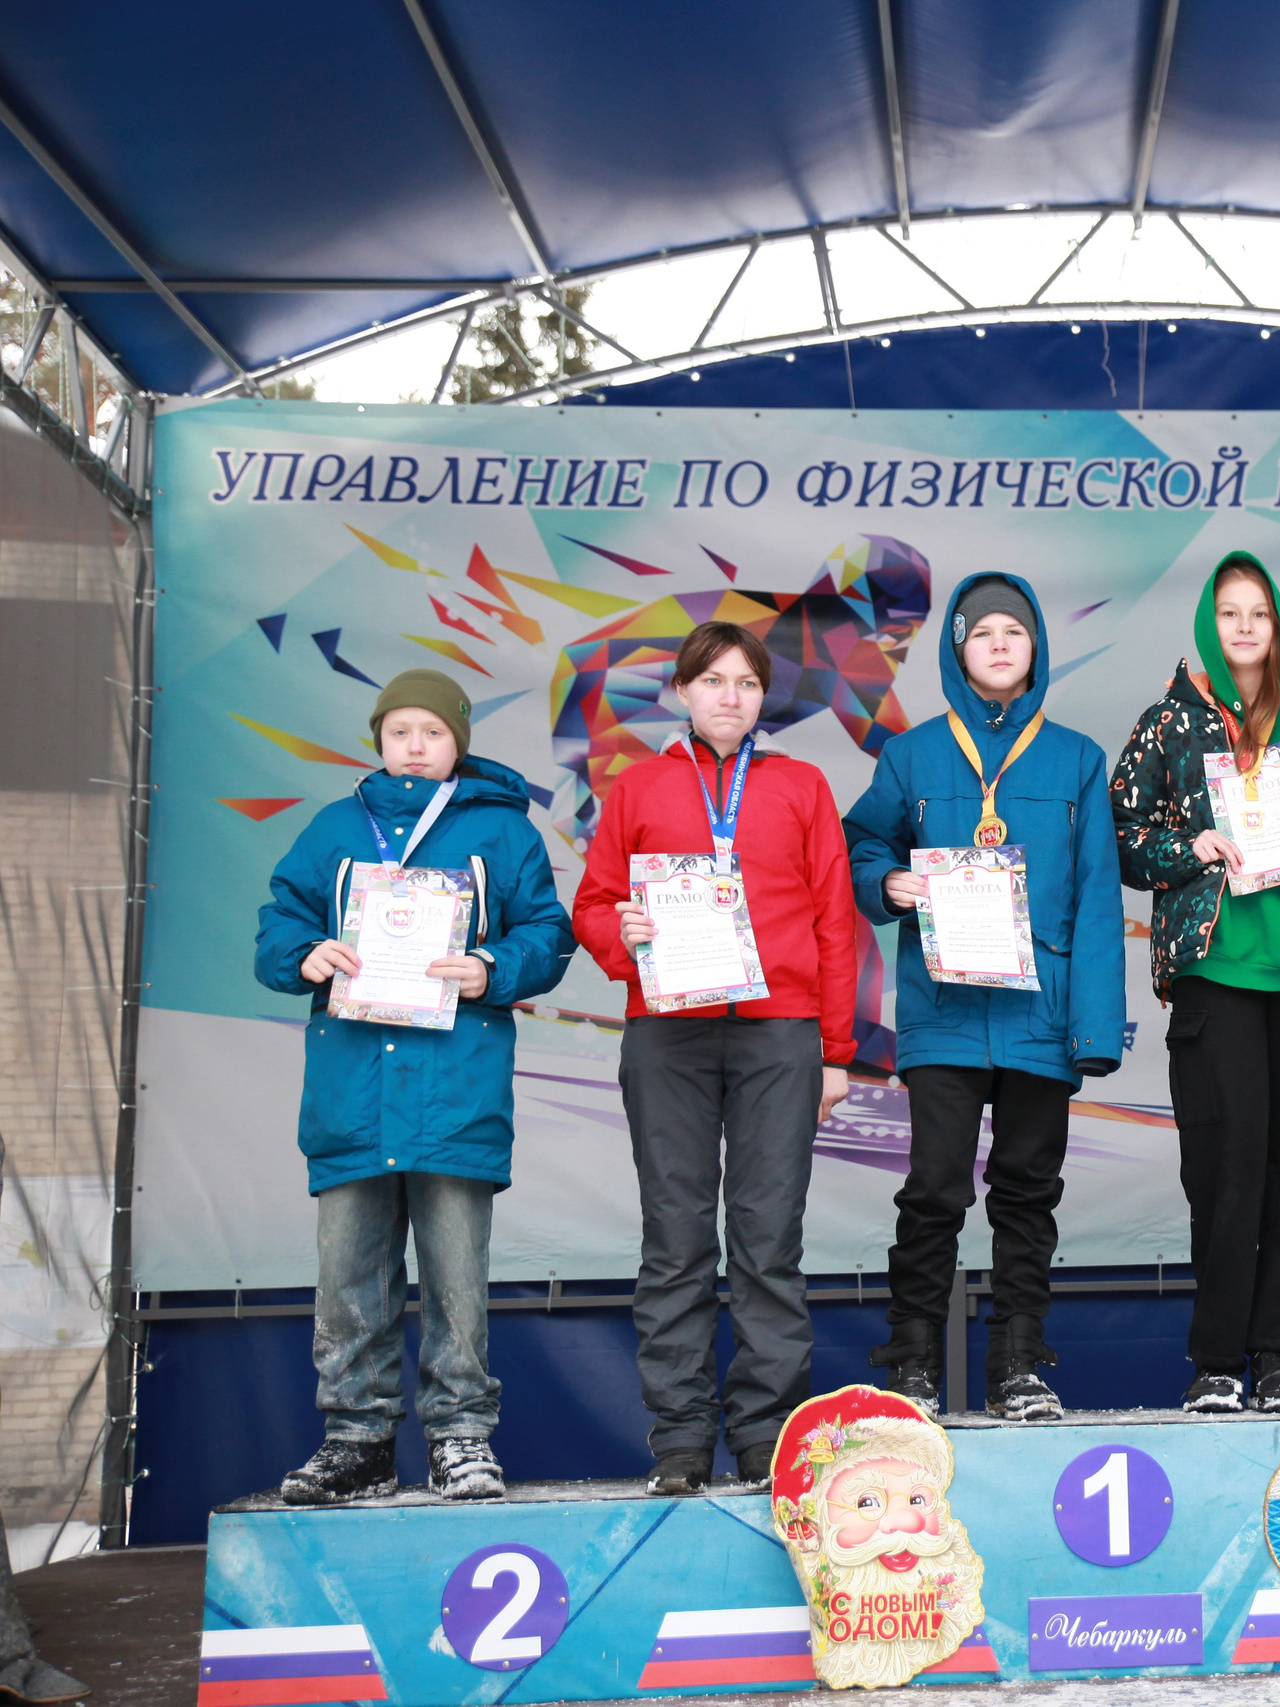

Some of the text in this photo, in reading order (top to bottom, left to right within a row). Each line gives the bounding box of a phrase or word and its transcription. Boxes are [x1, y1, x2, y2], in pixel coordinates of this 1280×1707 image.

[212, 450, 648, 509] УПРАВЛЕНИЕ
[674, 459, 770, 508] ПО
[797, 446, 1250, 508] ФИЗИЧЕСКОЙ
[727, 790, 741, 824] ОБЛАСТЬ
[656, 891, 707, 905] ГРАМО
[938, 883, 1002, 896] ГРАМОТА
[1083, 1451, 1131, 1557] 1
[470, 1551, 542, 1663] 2
[830, 1591, 936, 1616] С НОВЫМ
[1044, 1613, 1188, 1652] Чебаркуль
